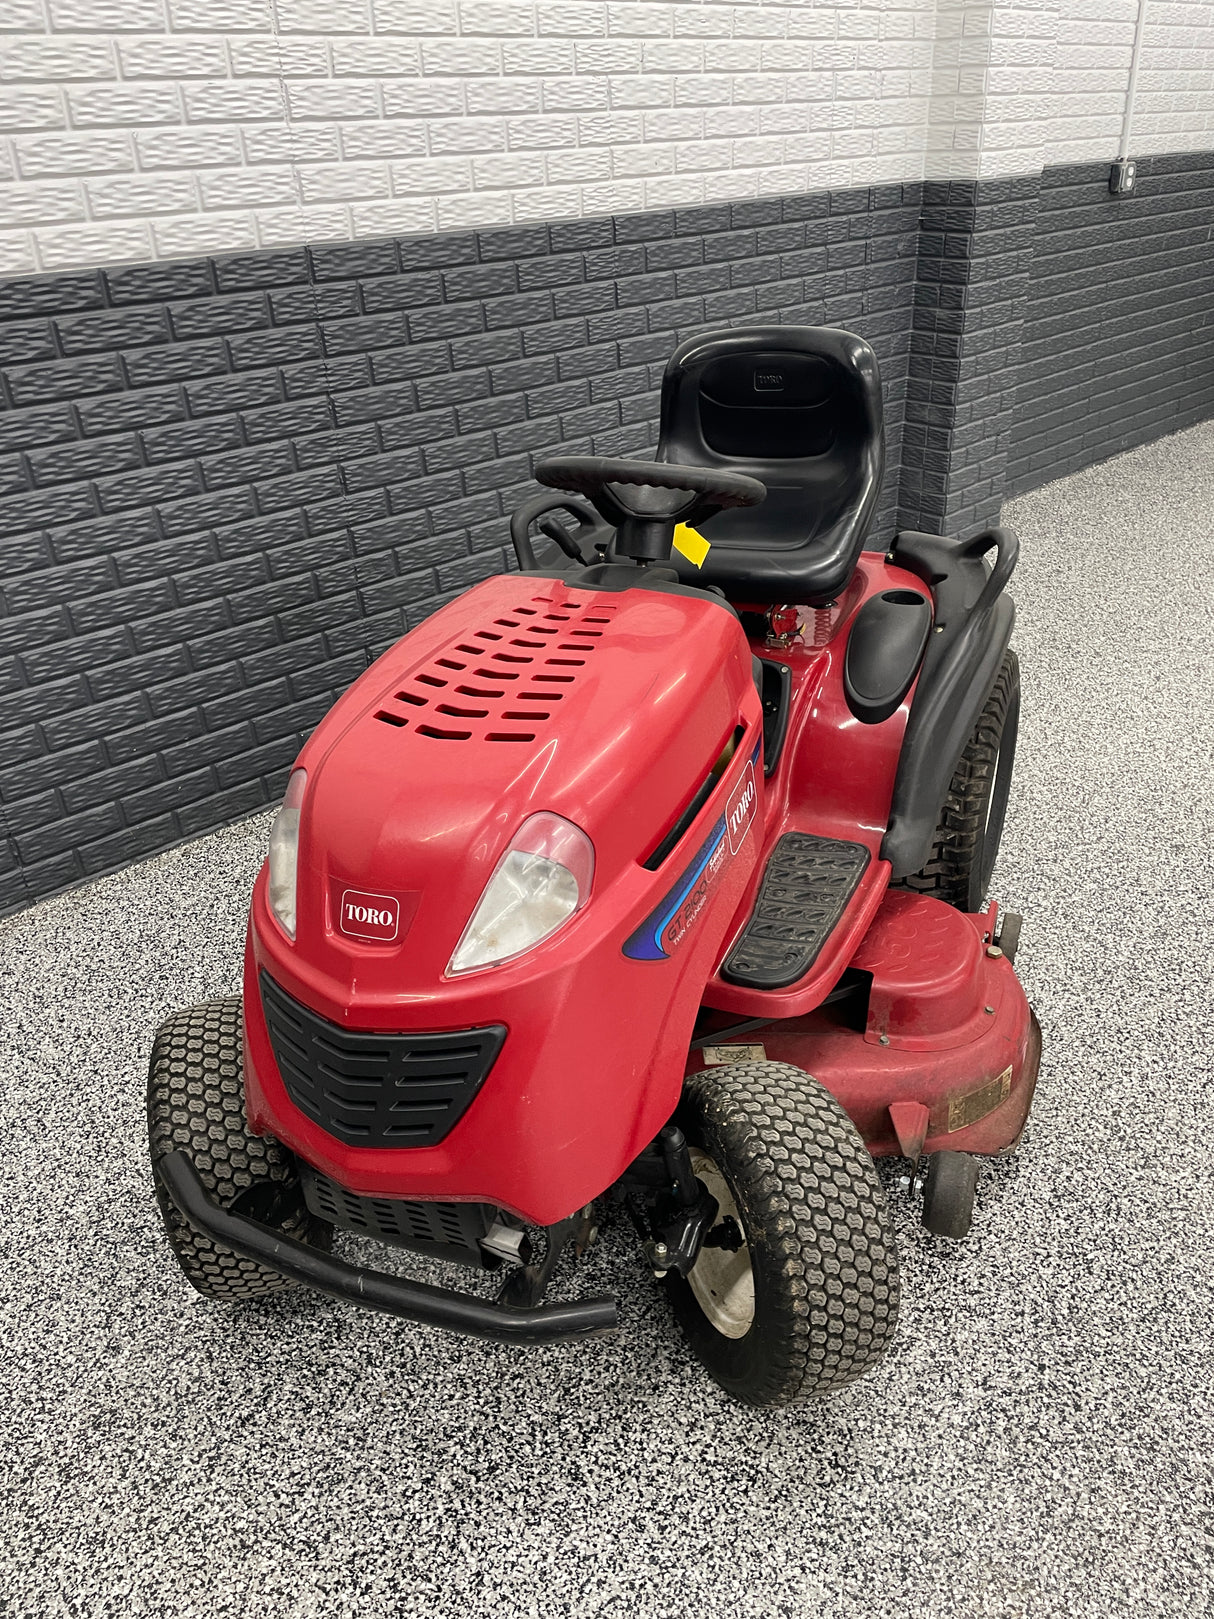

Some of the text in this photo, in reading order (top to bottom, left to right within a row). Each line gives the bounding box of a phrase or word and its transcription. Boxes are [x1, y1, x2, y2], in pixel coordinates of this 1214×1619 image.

[729, 781, 755, 835] TORO
[345, 903, 394, 926] TORO
[668, 915, 681, 941] GT
[673, 927, 686, 945] TWIN
